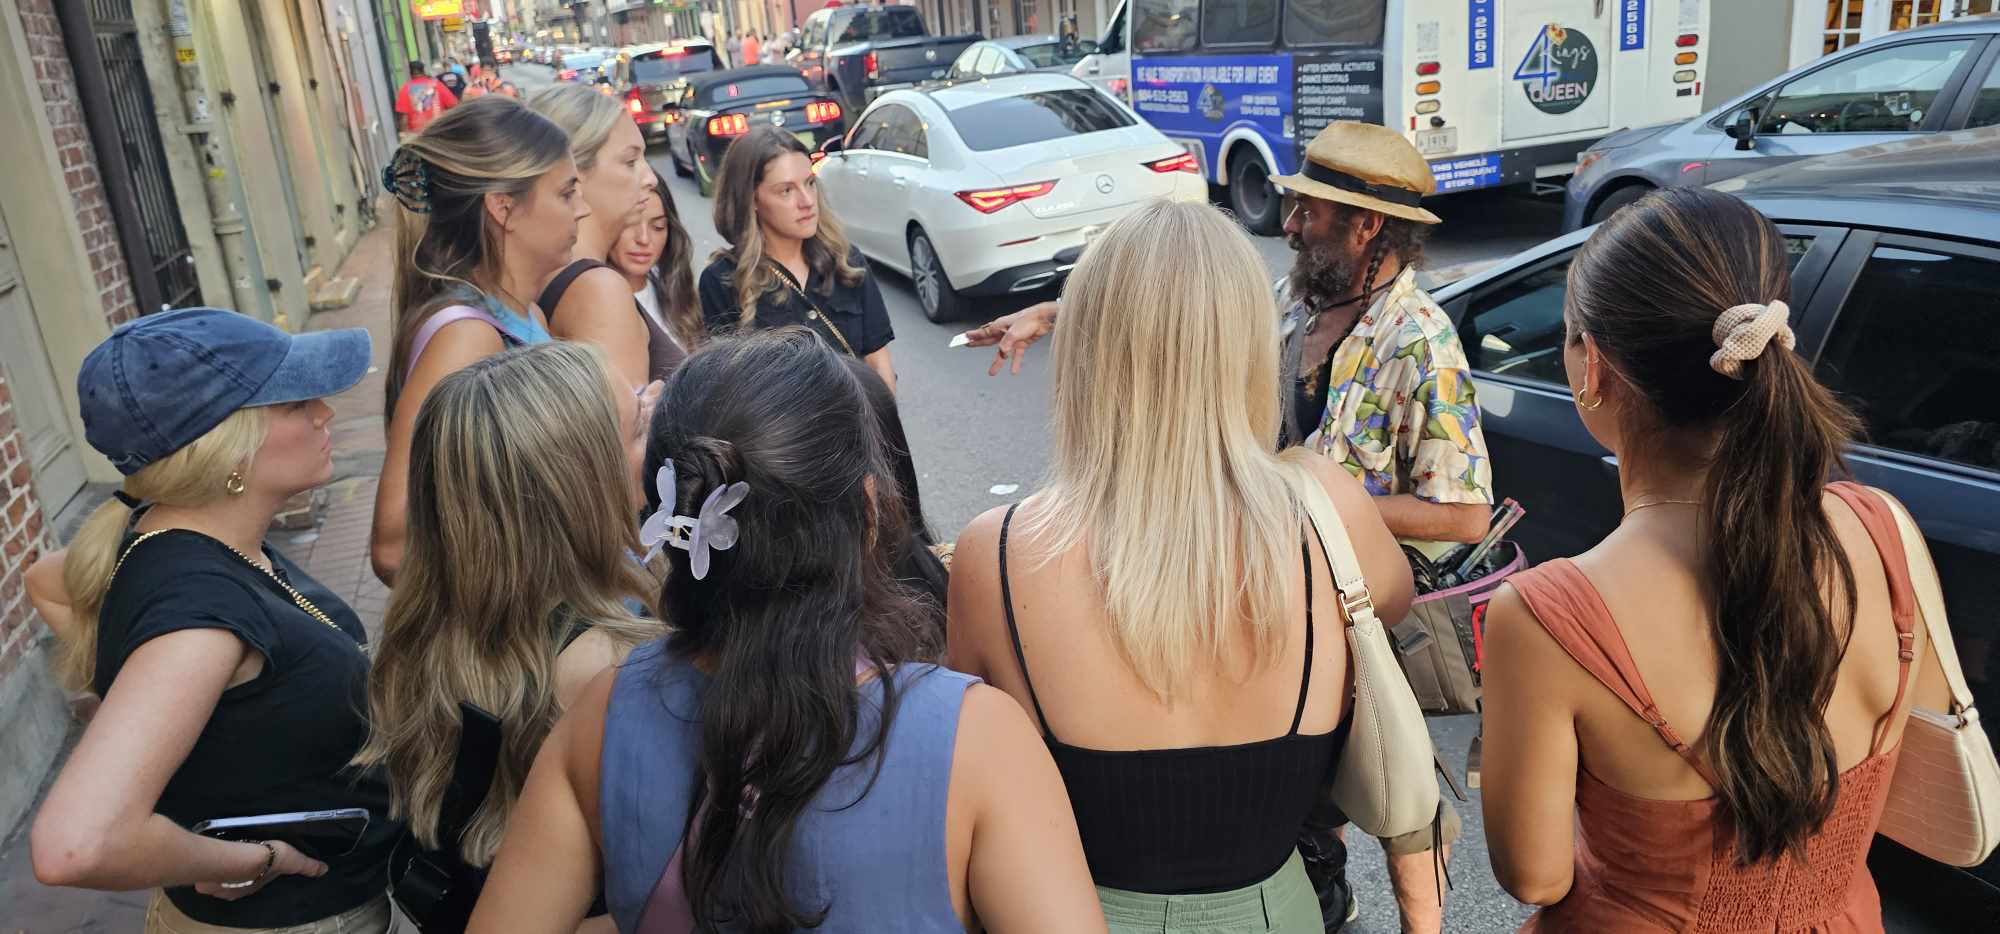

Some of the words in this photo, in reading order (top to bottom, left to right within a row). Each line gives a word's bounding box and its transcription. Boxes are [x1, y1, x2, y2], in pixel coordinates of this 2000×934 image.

[1474, 0, 1488, 63] -2563
[1512, 24, 1560, 93] 4
[1303, 64, 1320, 73] AFTER
[1320, 63, 1343, 72] SCHOOL
[1343, 61, 1376, 71] ACTIVITIES
[1158, 66, 1201, 82] TRANSPORTATION
[1202, 66, 1231, 83] AVAILABLE
[1231, 66, 1243, 83] FOR
[1244, 67, 1256, 83] ANY
[1258, 66, 1279, 84] EVENT
[1303, 74, 1321, 83] DANCE
[1322, 73, 1349, 83] RECITALS
[1529, 82, 1588, 102] QUEEN
[1303, 106, 1321, 115] DANCE
[1432, 162, 1452, 173] THIS
[1453, 158, 1488, 170] VEHICLE
[1454, 165, 1498, 178] FREQUENT
[1444, 178, 1475, 189] STOPS
